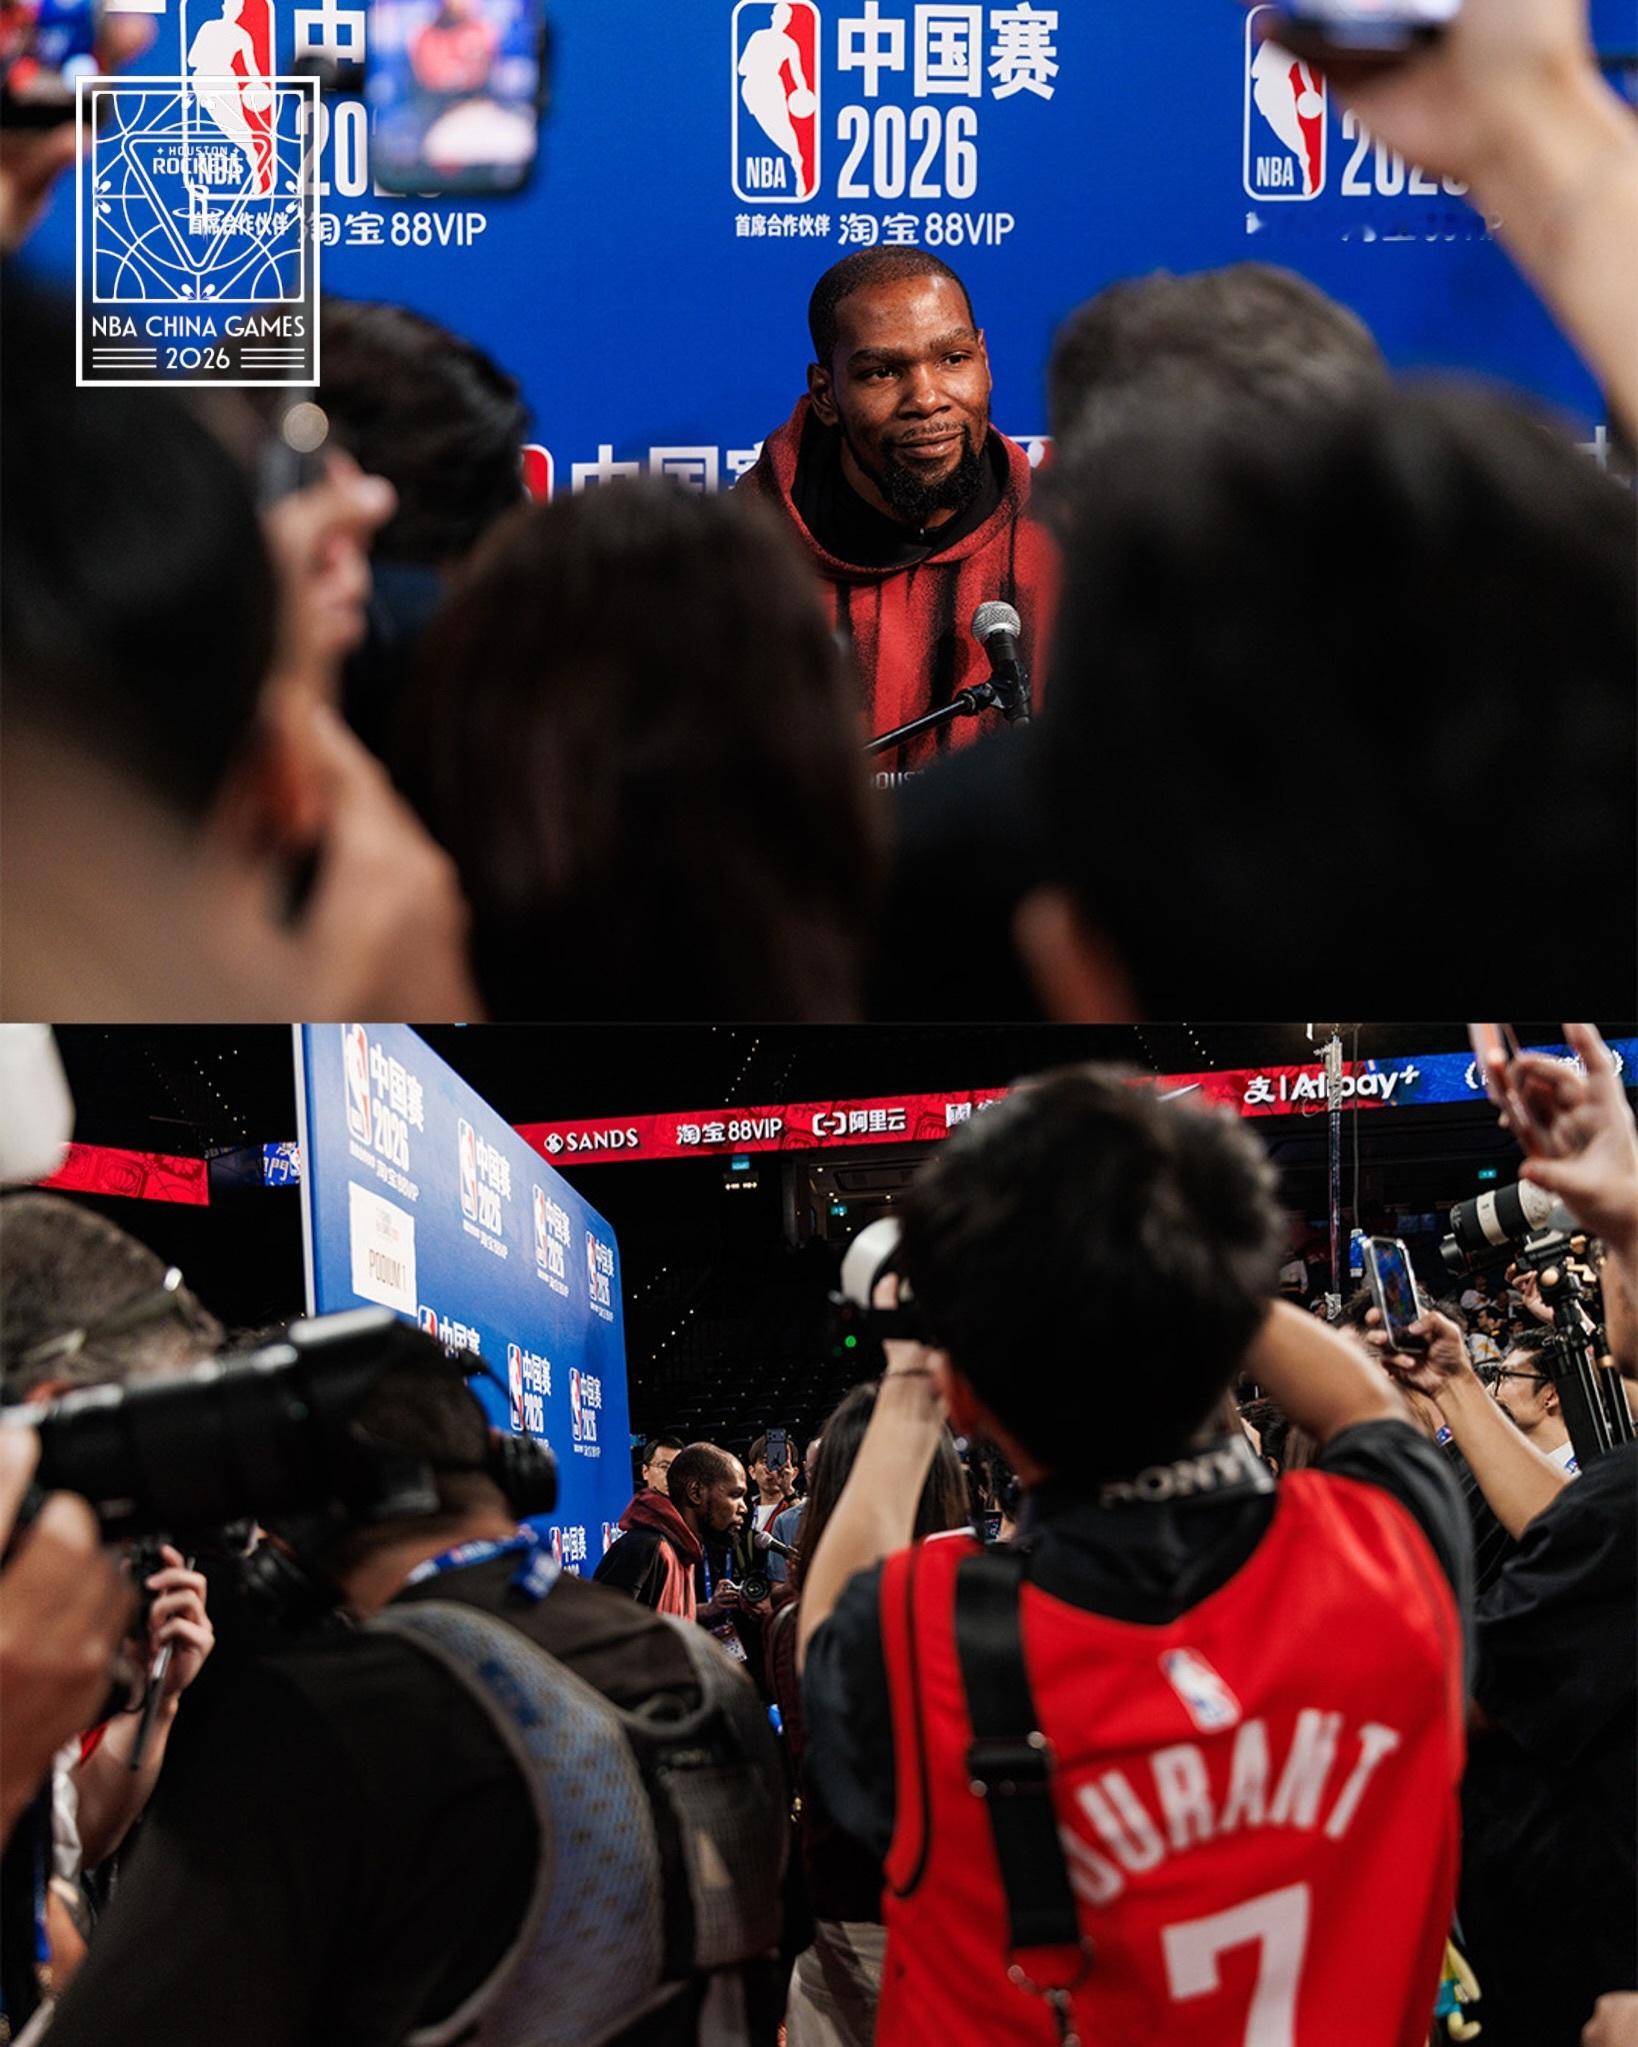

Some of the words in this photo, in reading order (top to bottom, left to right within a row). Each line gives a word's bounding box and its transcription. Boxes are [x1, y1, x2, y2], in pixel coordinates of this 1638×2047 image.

[837, 1, 1059, 100] 中国赛
[295, 101, 442, 197] 20
[746, 157, 787, 189] NBA
[837, 105, 978, 199] 2026
[1256, 157, 1294, 187] NBA
[1341, 108, 1470, 196] 20
[735, 214, 831, 237] 首席合作伙伴
[370, 1043, 424, 1133] 中国赛
[850, 1108, 906, 1133] 阿里云
[566, 1128, 639, 1151] SANDS
[1162, 1880, 1312, 2047] 7
